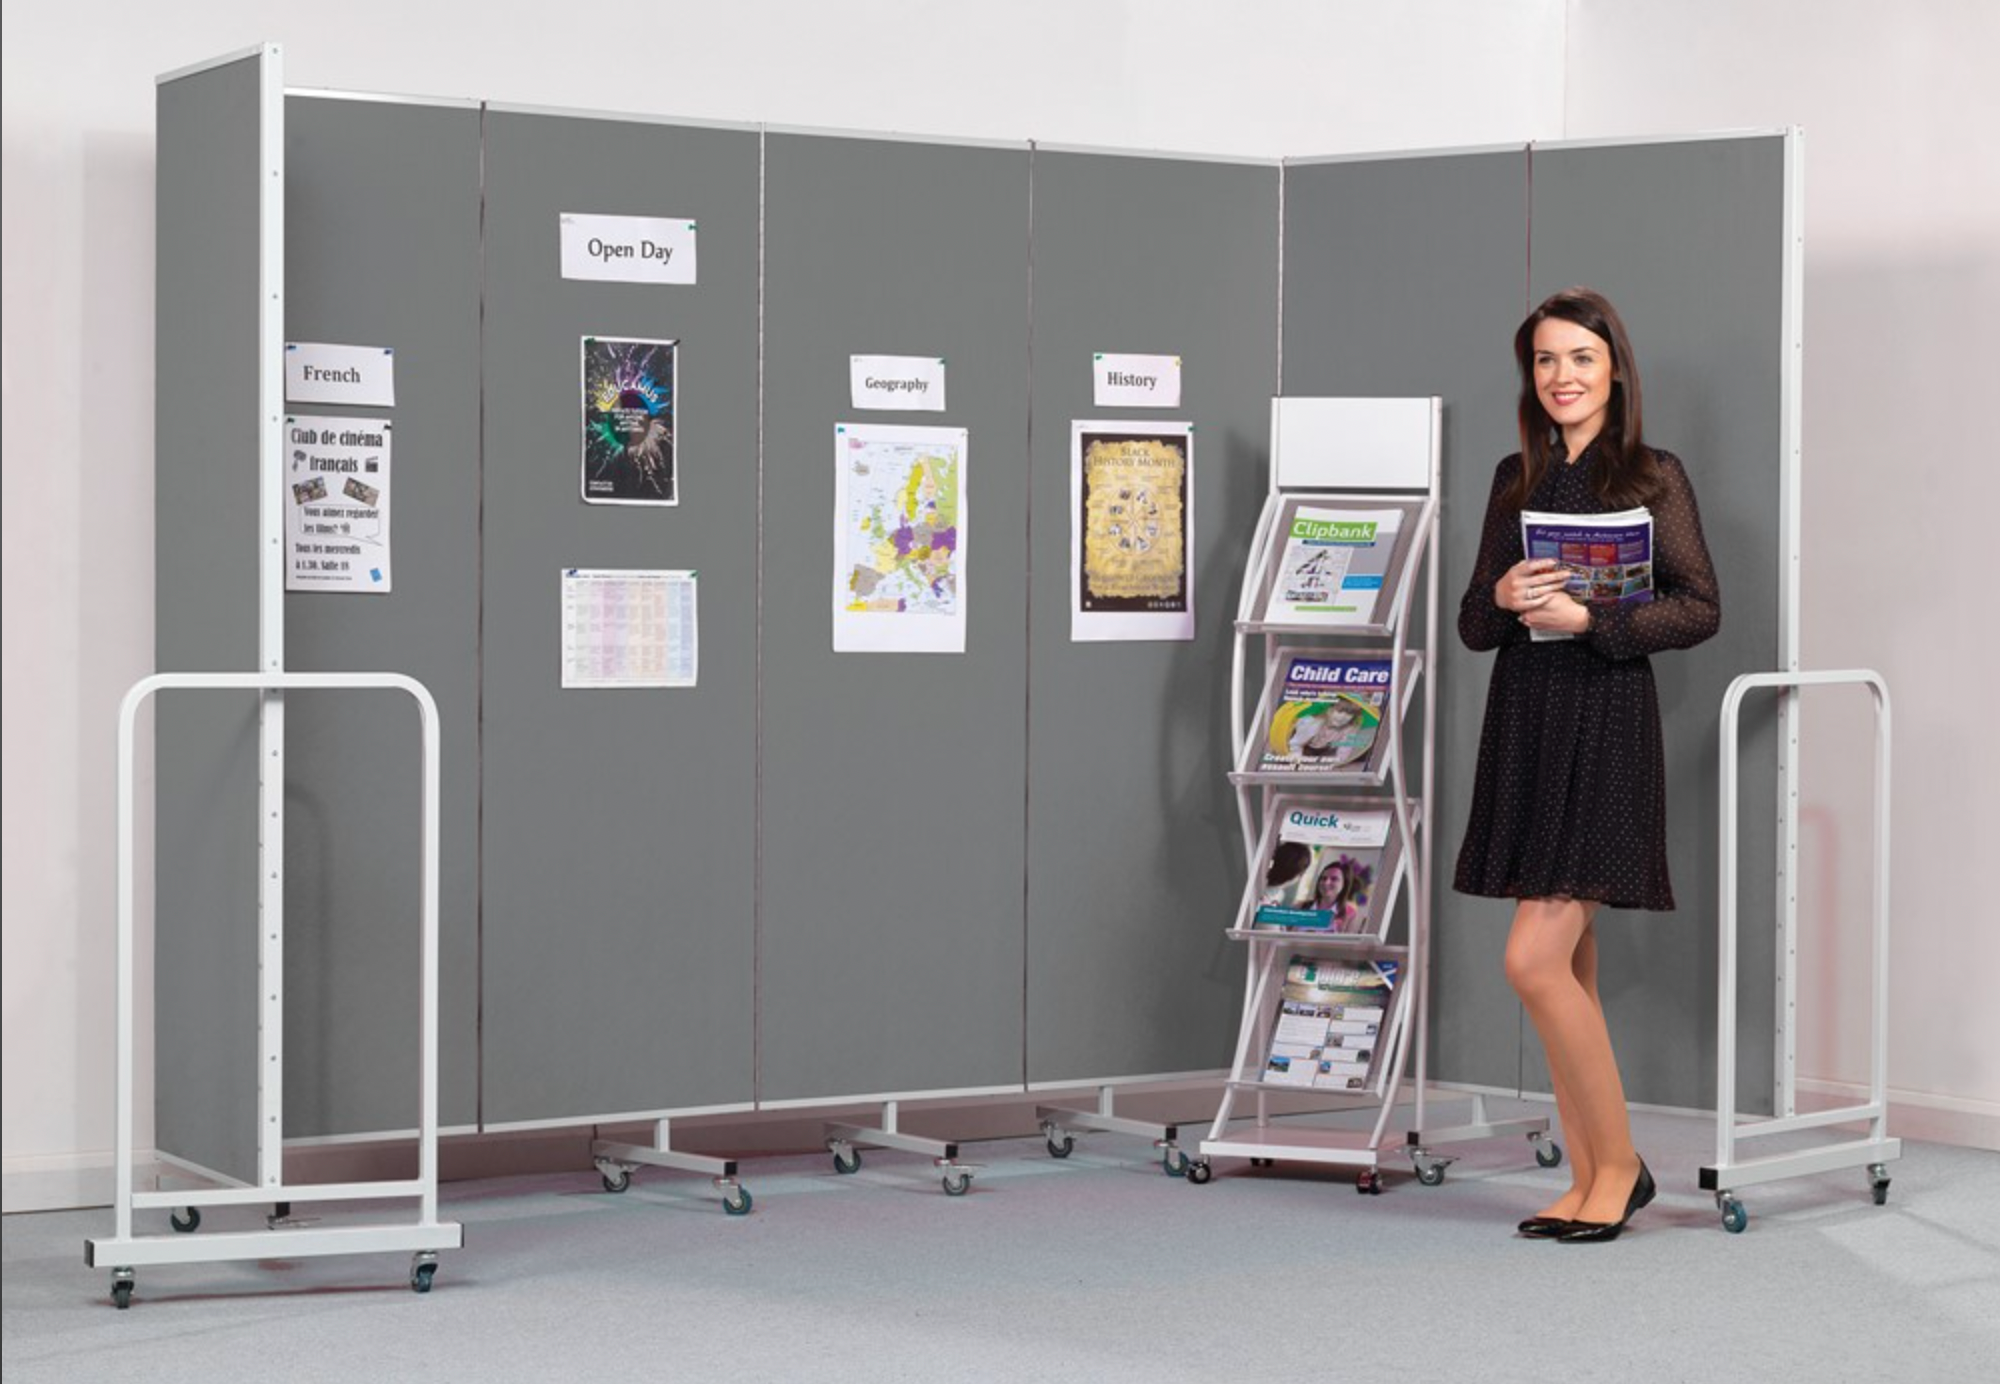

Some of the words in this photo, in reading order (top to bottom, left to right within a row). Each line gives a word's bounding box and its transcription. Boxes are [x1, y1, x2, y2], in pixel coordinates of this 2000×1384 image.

[588, 238, 634, 262] Open
[642, 240, 673, 265] Day
[303, 364, 361, 384] French
[1107, 371, 1157, 391] History
[865, 377, 930, 393] Geography
[291, 427, 317, 445] Club
[321, 430, 337, 445] de
[340, 430, 383, 447] cinéma
[1121, 446, 1151, 457] BLACK
[309, 455, 358, 473] français
[1093, 456, 1136, 467] HISTORY
[1137, 457, 1175, 468] MONTH
[1293, 521, 1372, 540] Clipbank
[1290, 665, 1342, 683] Child
[1344, 668, 1390, 683] Care
[1289, 811, 1340, 829] Quick
